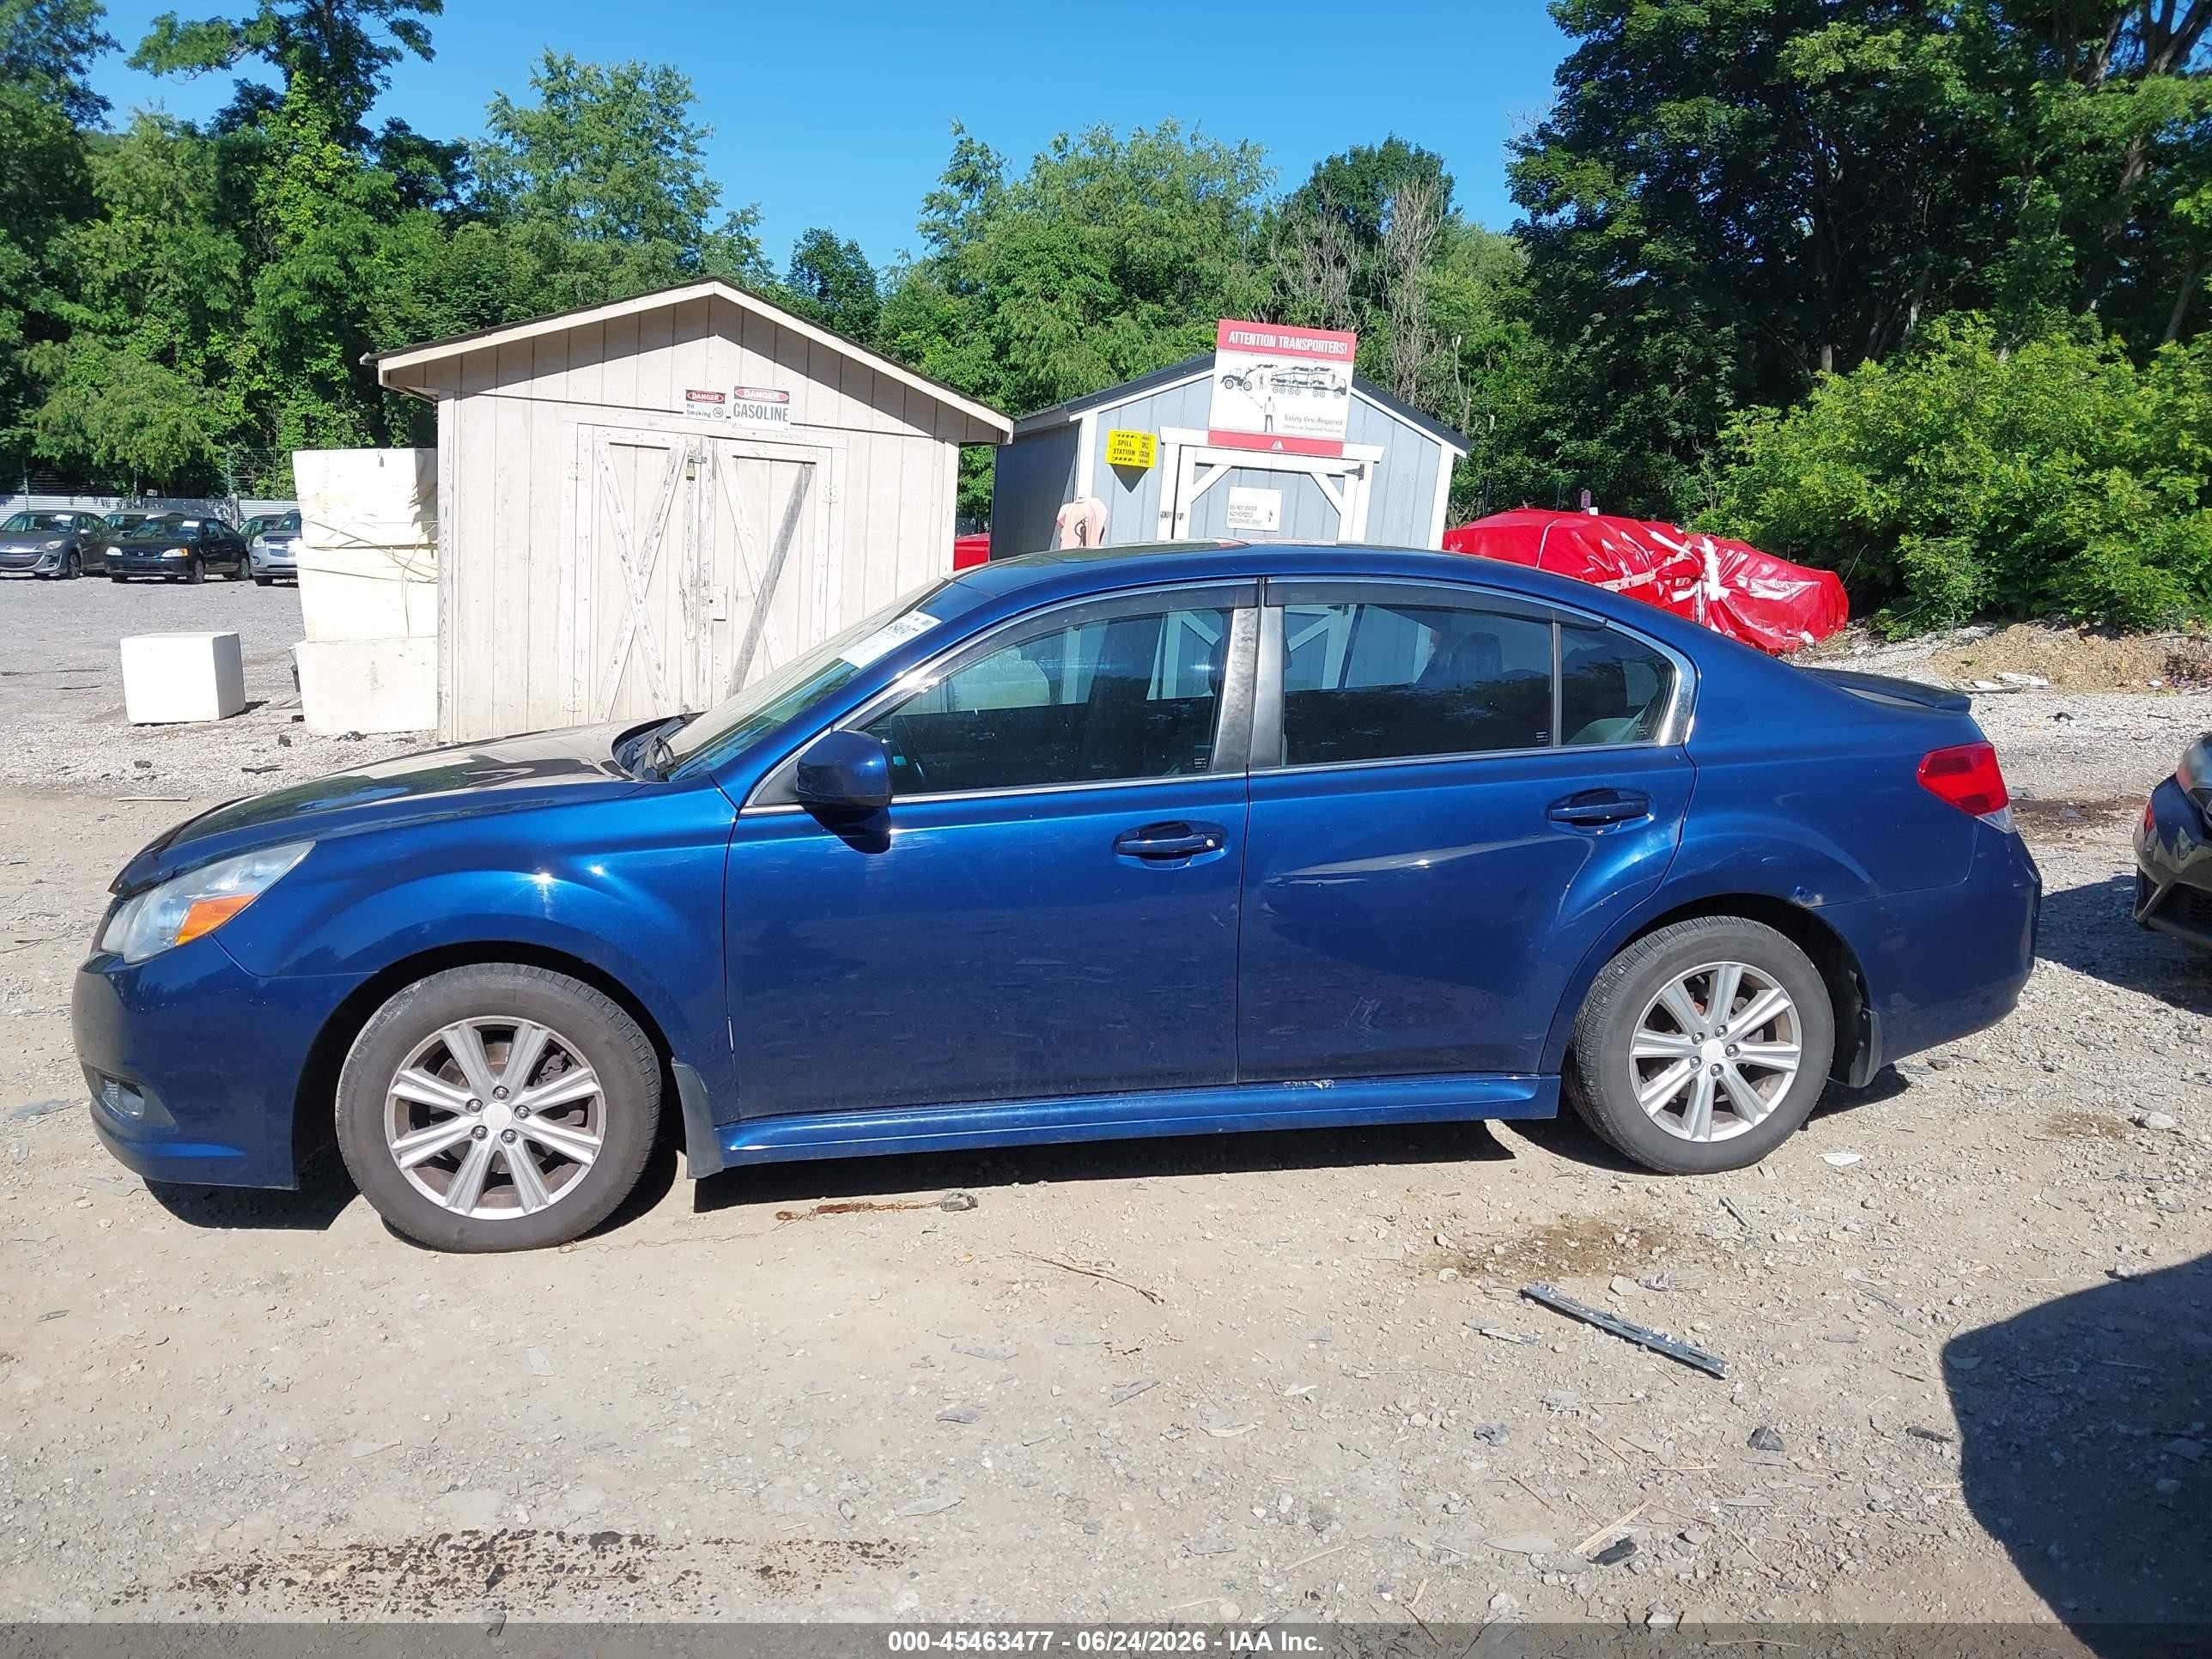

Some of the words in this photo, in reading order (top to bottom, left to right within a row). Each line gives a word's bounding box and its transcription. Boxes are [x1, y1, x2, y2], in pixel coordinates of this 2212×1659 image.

[1228, 331, 1276, 348] ATTENTION
[1279, 336, 1348, 355] TRANSPORTERS!
[691, 392, 719, 401] DANGER
[744, 390, 781, 400] DANGER
[687, 410, 711, 418] Smoking
[733, 403, 789, 422] GASOLINE
[1284, 414, 1302, 423] Safety
